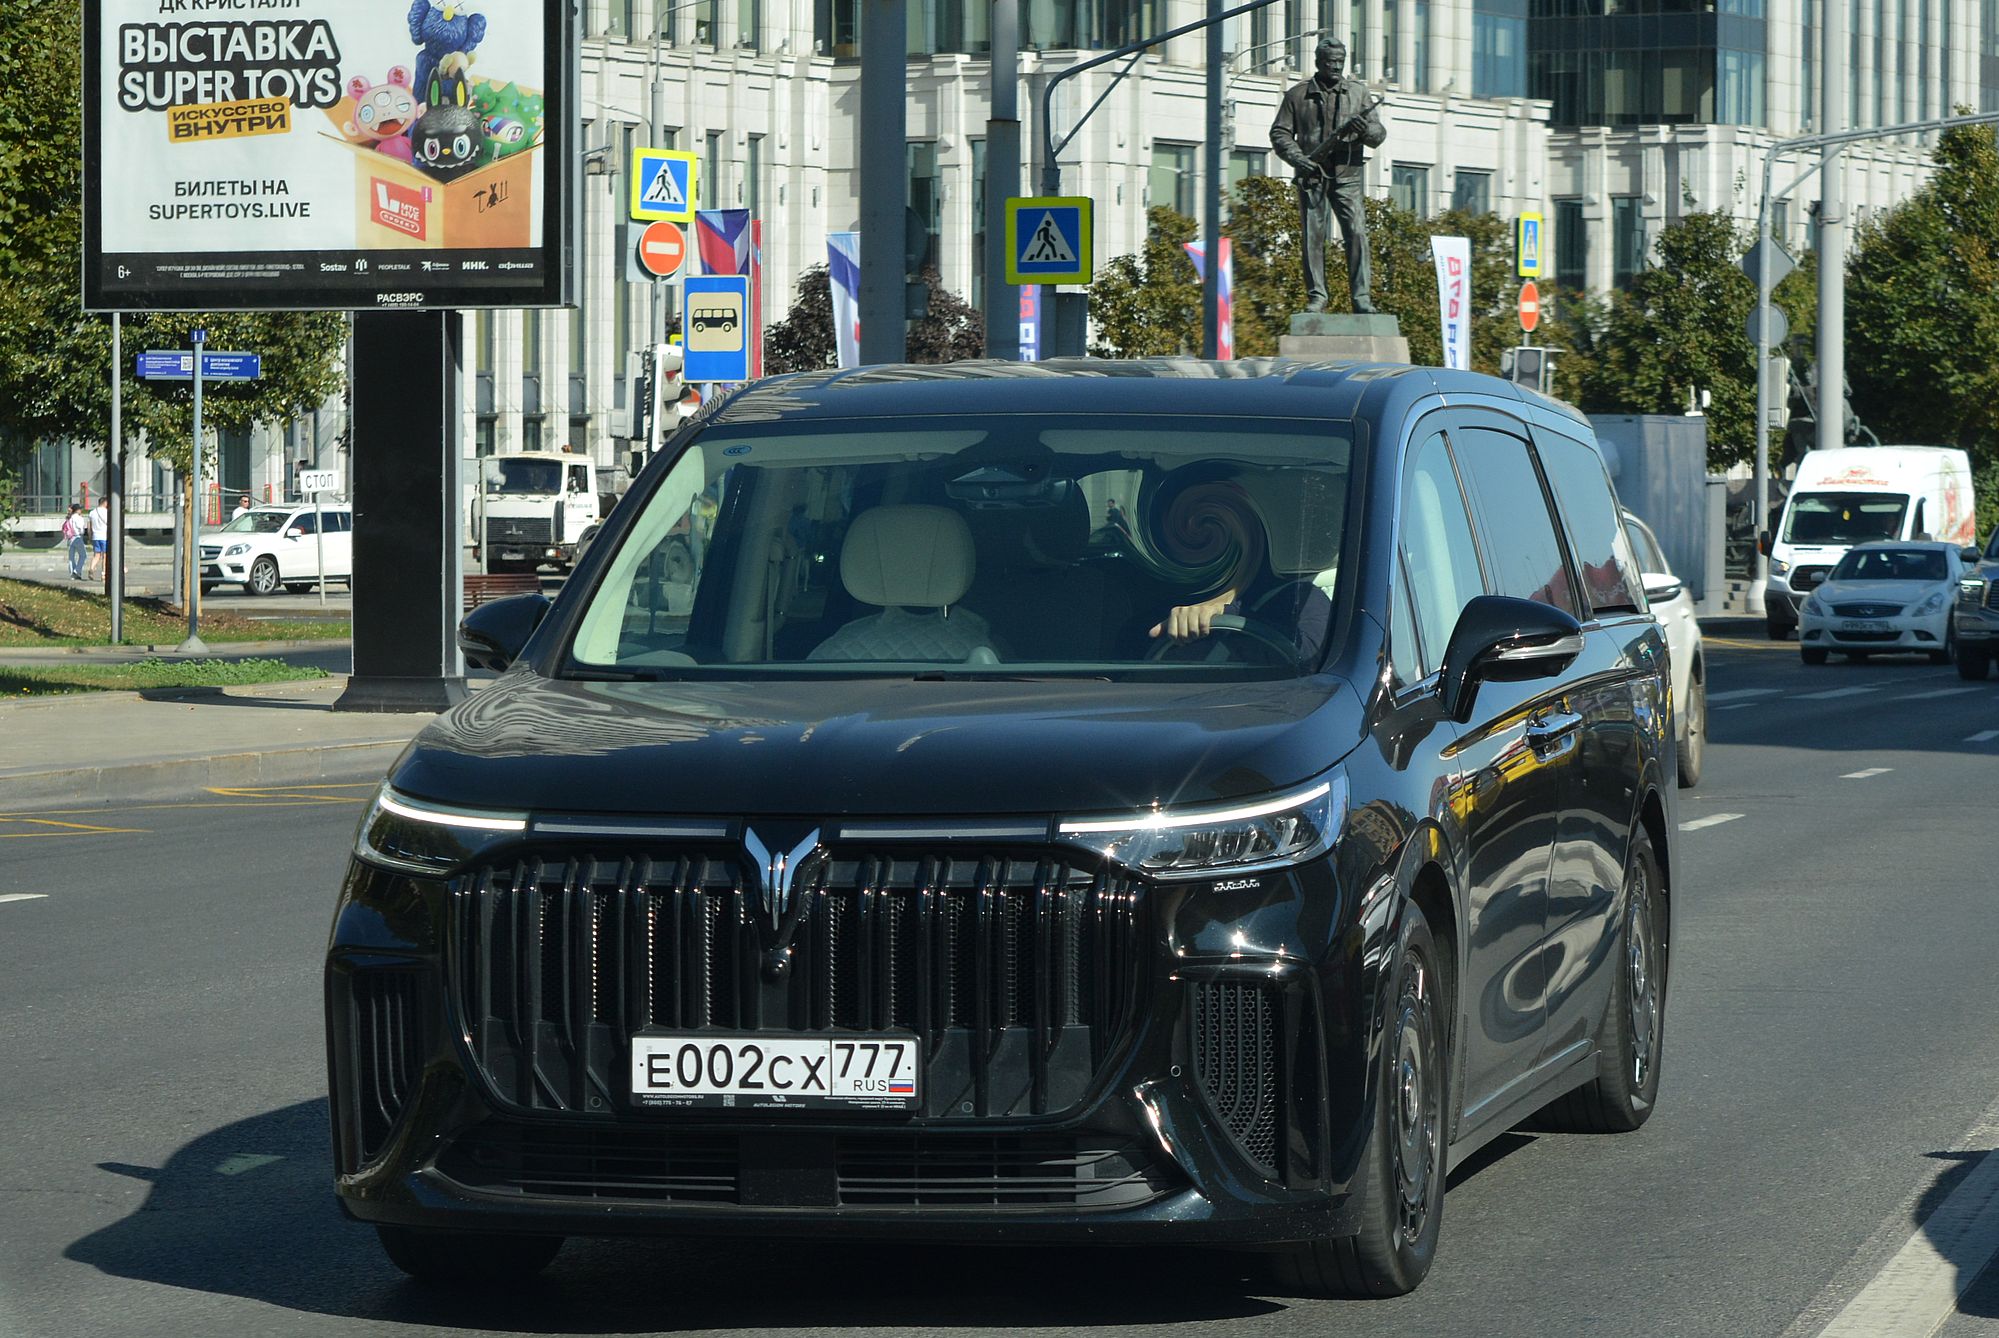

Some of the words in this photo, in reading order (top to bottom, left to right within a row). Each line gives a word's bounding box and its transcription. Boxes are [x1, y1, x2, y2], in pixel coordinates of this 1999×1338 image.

[124, 25, 335, 64] ВЫСТАВКА
[123, 69, 236, 106] SUPER
[243, 67, 337, 104] TOYS
[173, 102, 285, 122] ИСКУССТВО
[174, 114, 286, 138] ВНУТРИ
[175, 180, 257, 197] БИЛЕТЫ
[262, 180, 289, 195] НА
[149, 202, 311, 220] SUPERTOYS.LIVE
[117, 265, 132, 279] 6+
[320, 262, 348, 272] Sostav
[462, 261, 490, 270] ИНК.
[377, 292, 424, 303] РАСВЭРС
[306, 474, 333, 488] СТОП
[835, 1043, 905, 1078] 777
[853, 1079, 887, 1091] RUS
